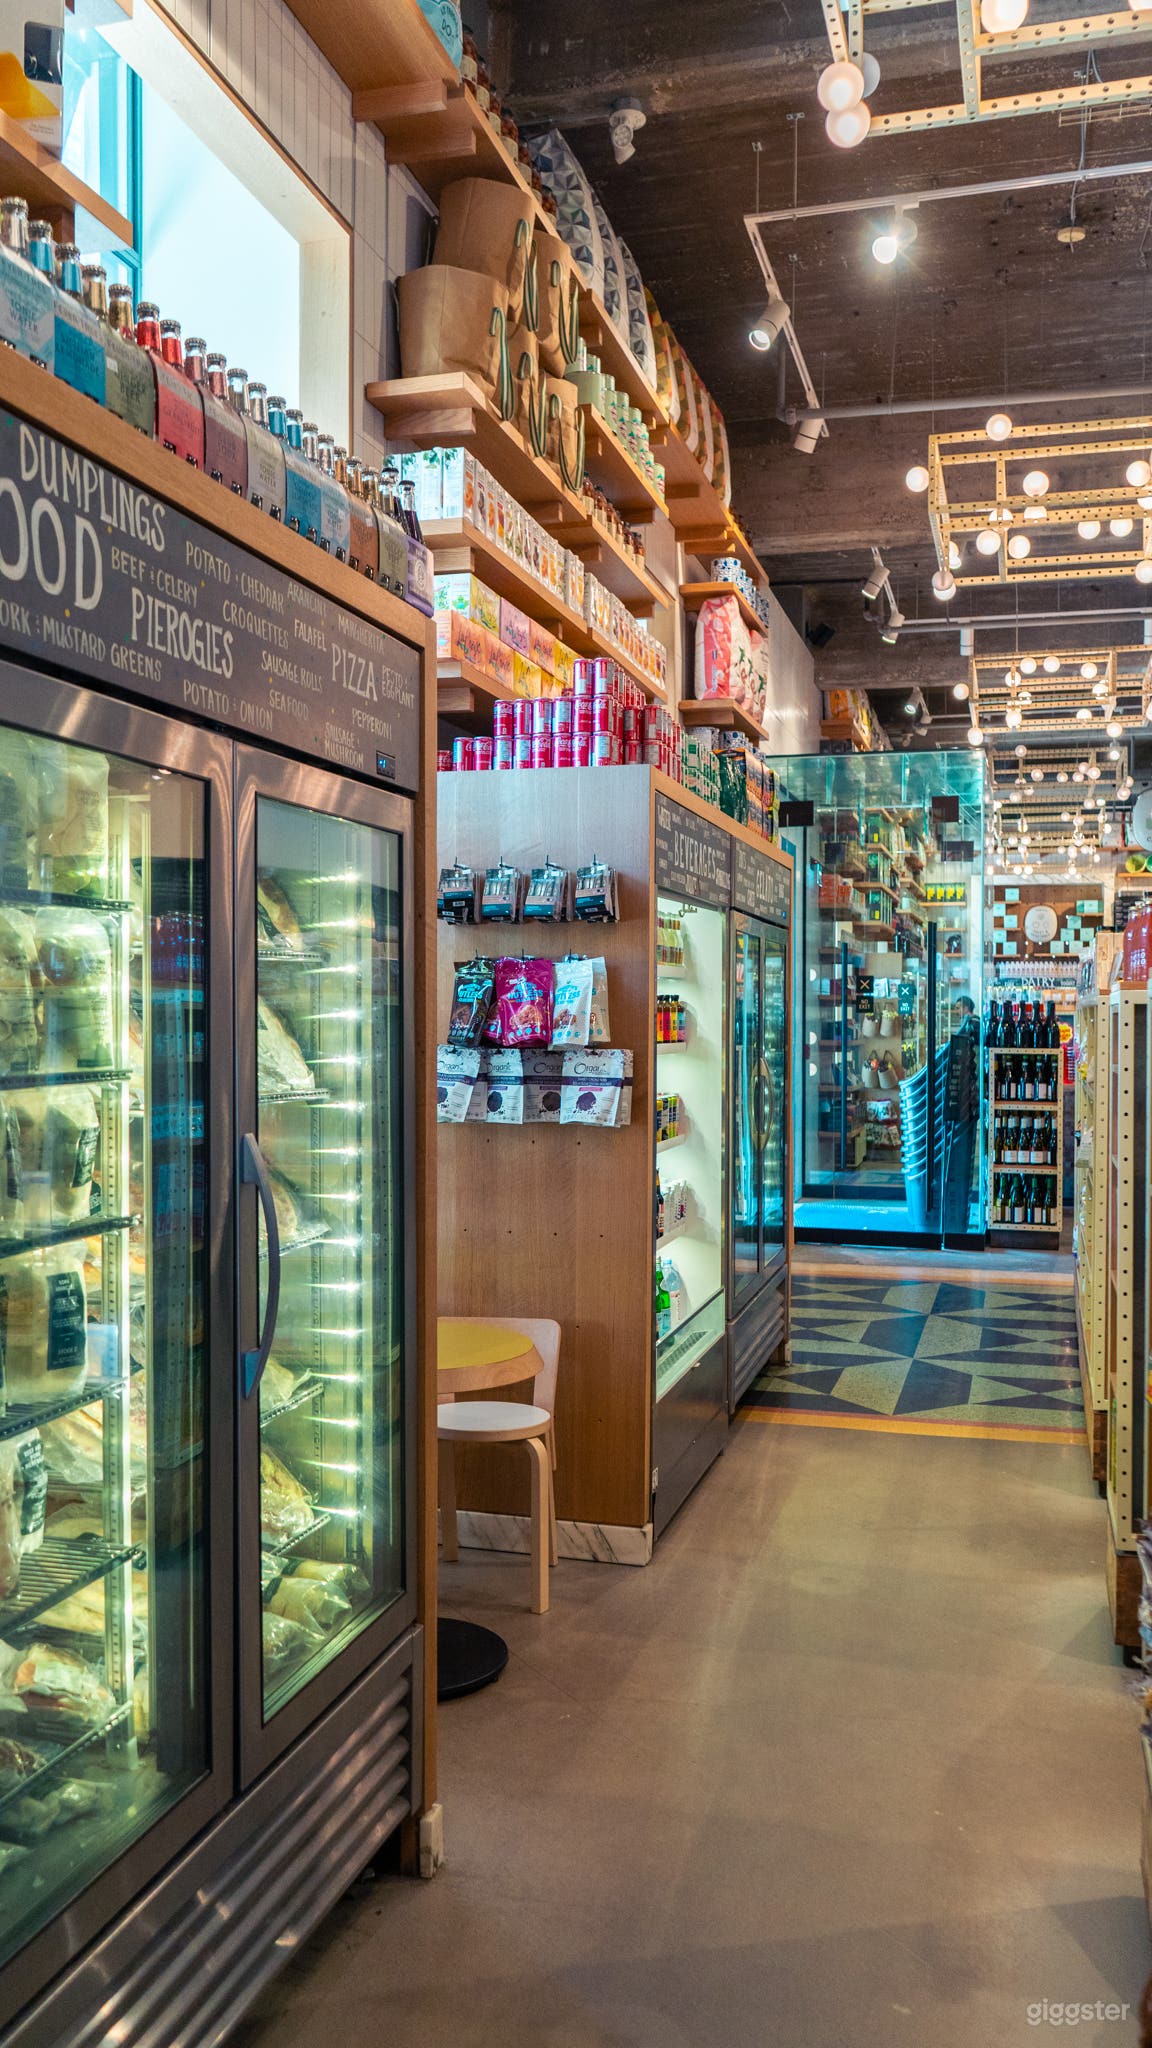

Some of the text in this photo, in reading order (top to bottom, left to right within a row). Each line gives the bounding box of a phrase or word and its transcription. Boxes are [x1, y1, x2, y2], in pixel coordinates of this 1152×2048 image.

[19, 423, 166, 552] DUMPLINGS
[111, 546, 146, 583] BEEF
[156, 568, 198, 608] CELERY
[185, 540, 231, 585] POTATO
[241, 571, 285, 616] CHEDDAR
[42, 615, 106, 662] MUSTARD
[110, 642, 162, 682] GREENS
[131, 586, 234, 679] PIEROGIES
[222, 600, 289, 650] CROQUETTES
[294, 618, 327, 653] FALAFEL
[261, 650, 323, 694] SAUSAGE ROLLS
[331, 642, 378, 702] PIZZA
[381, 680, 416, 710] EGGPLANT
[183, 679, 230, 715] POTATO
[240, 700, 273, 732] ONION
[269, 689, 310, 721] SEAFOOD
[351, 707, 392, 742] PEPPERONI
[324, 738, 364, 770] MUSHROOM
[674, 830, 716, 880] BEVERAGES
[1021, 976, 1055, 988] DAIRY
